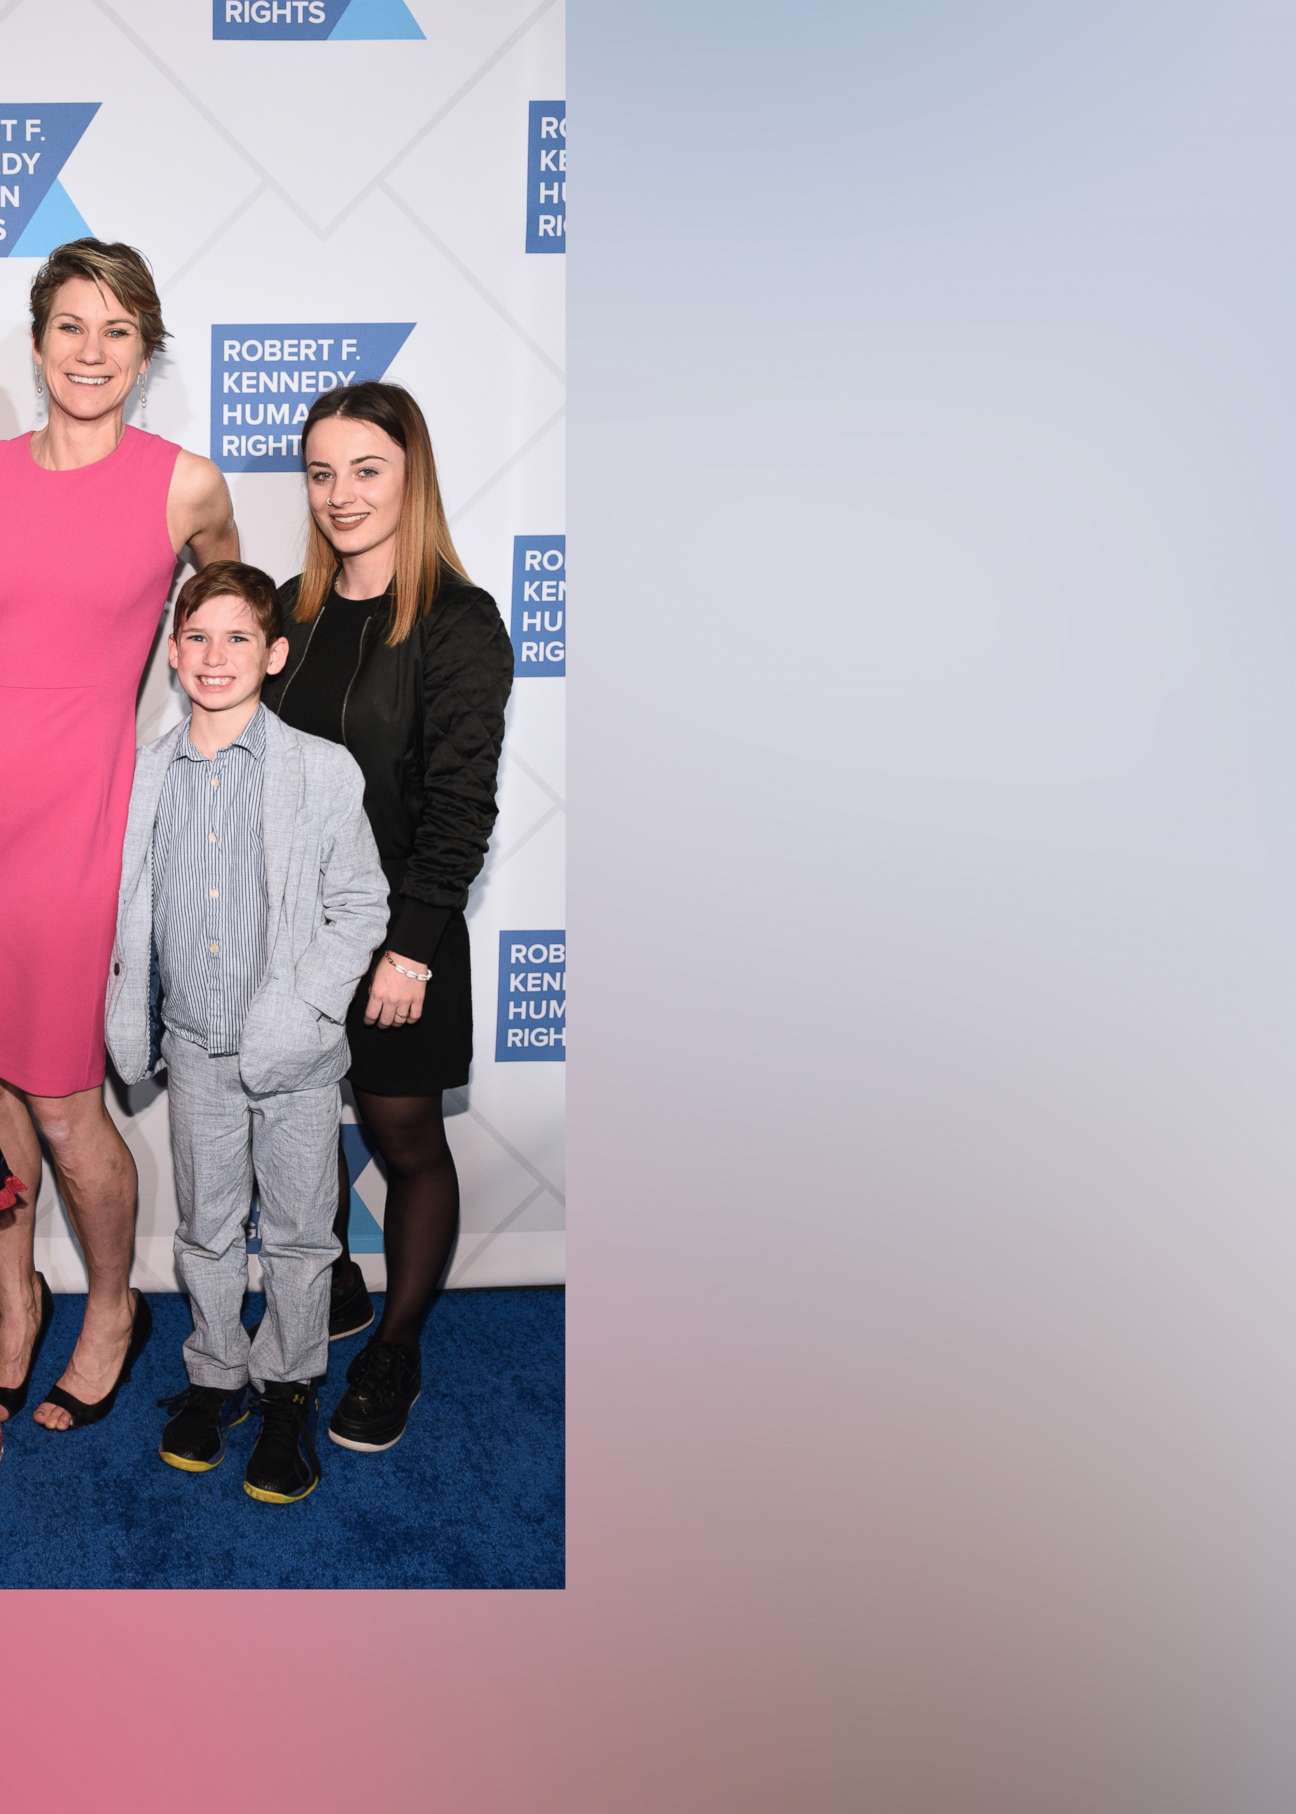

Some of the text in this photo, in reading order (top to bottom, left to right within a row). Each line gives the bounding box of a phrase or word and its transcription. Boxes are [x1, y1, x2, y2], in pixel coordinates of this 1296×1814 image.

[225, 1, 326, 24] RIGHTS
[25, 119, 46, 141] F.
[223, 339, 360, 362] ROBERT F.
[223, 371, 355, 393] KENNEDY
[222, 435, 302, 456] RIGHT
[524, 550, 565, 571] RO
[509, 972, 565, 992] KEN
